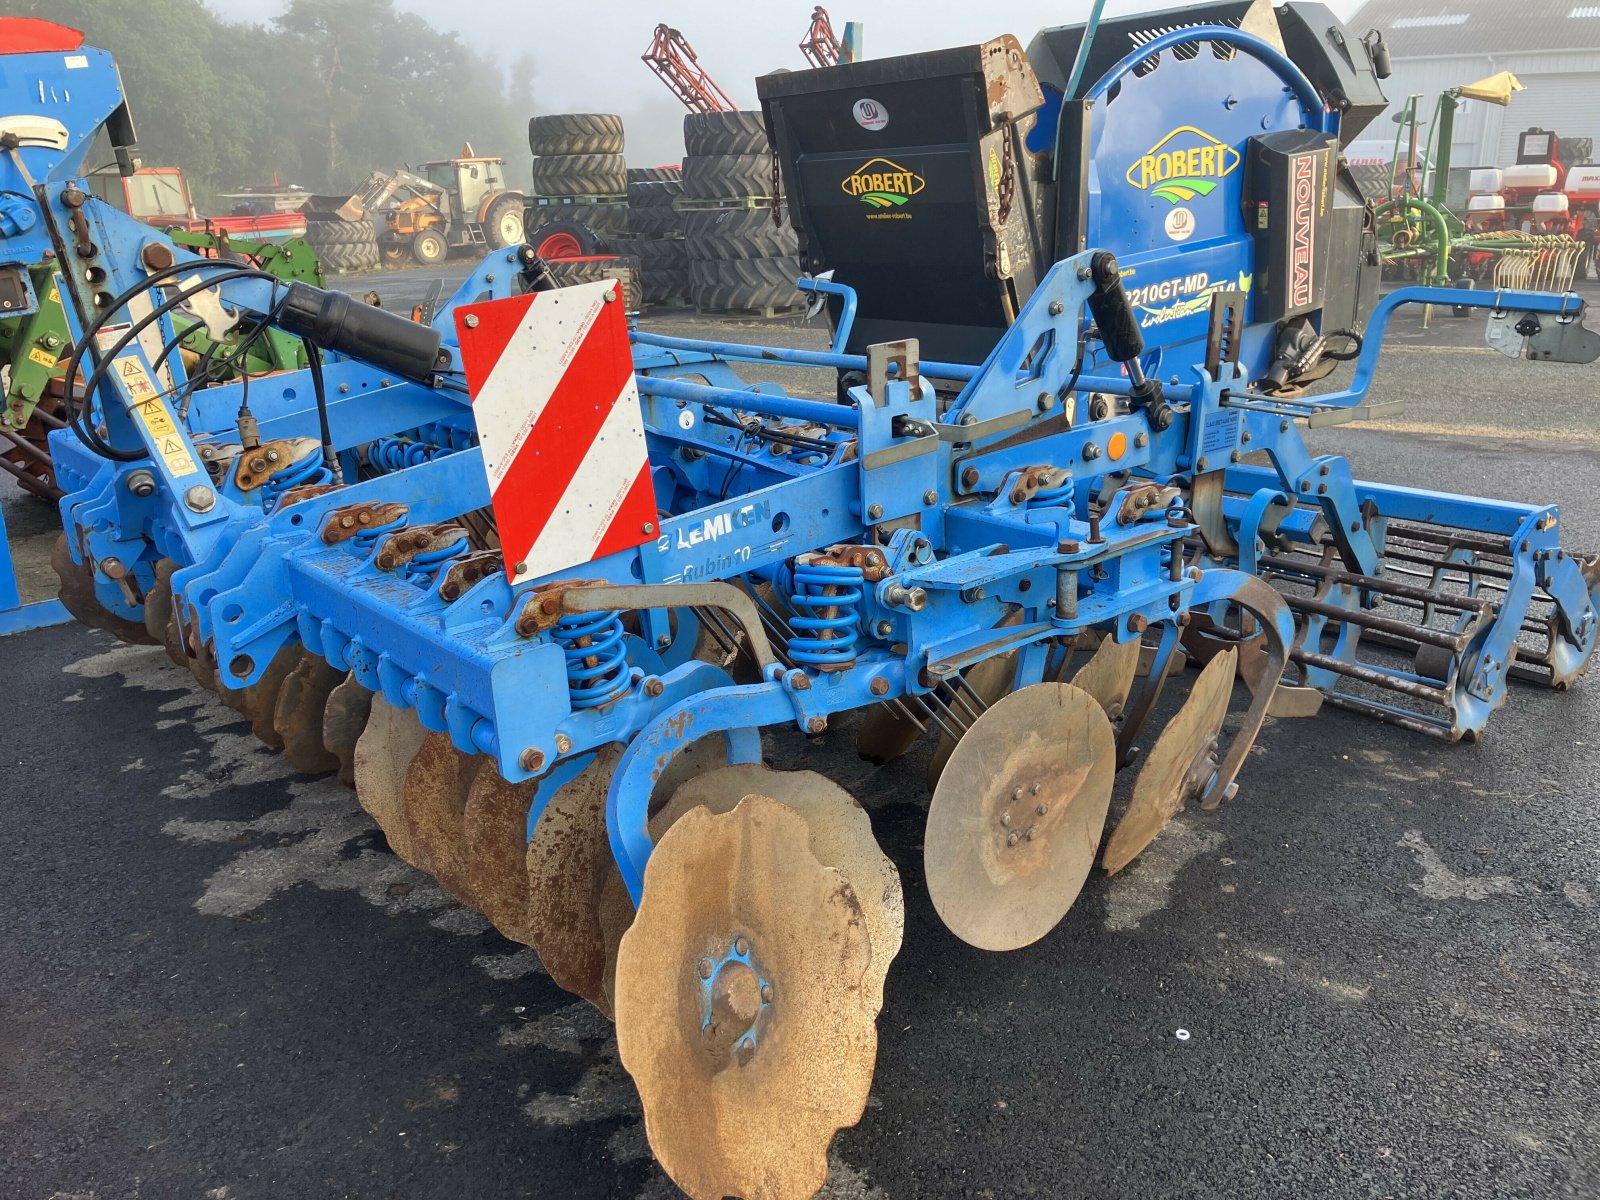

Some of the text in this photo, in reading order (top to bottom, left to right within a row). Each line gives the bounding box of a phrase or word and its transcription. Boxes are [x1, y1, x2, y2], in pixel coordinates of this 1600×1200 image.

[850, 172, 914, 196] ROBERT
[1141, 144, 1228, 189] ROBERT
[1294, 156, 1312, 306] NOUVEAU
[675, 500, 771, 549] LEMKEN
[682, 553, 732, 582] Rubin
